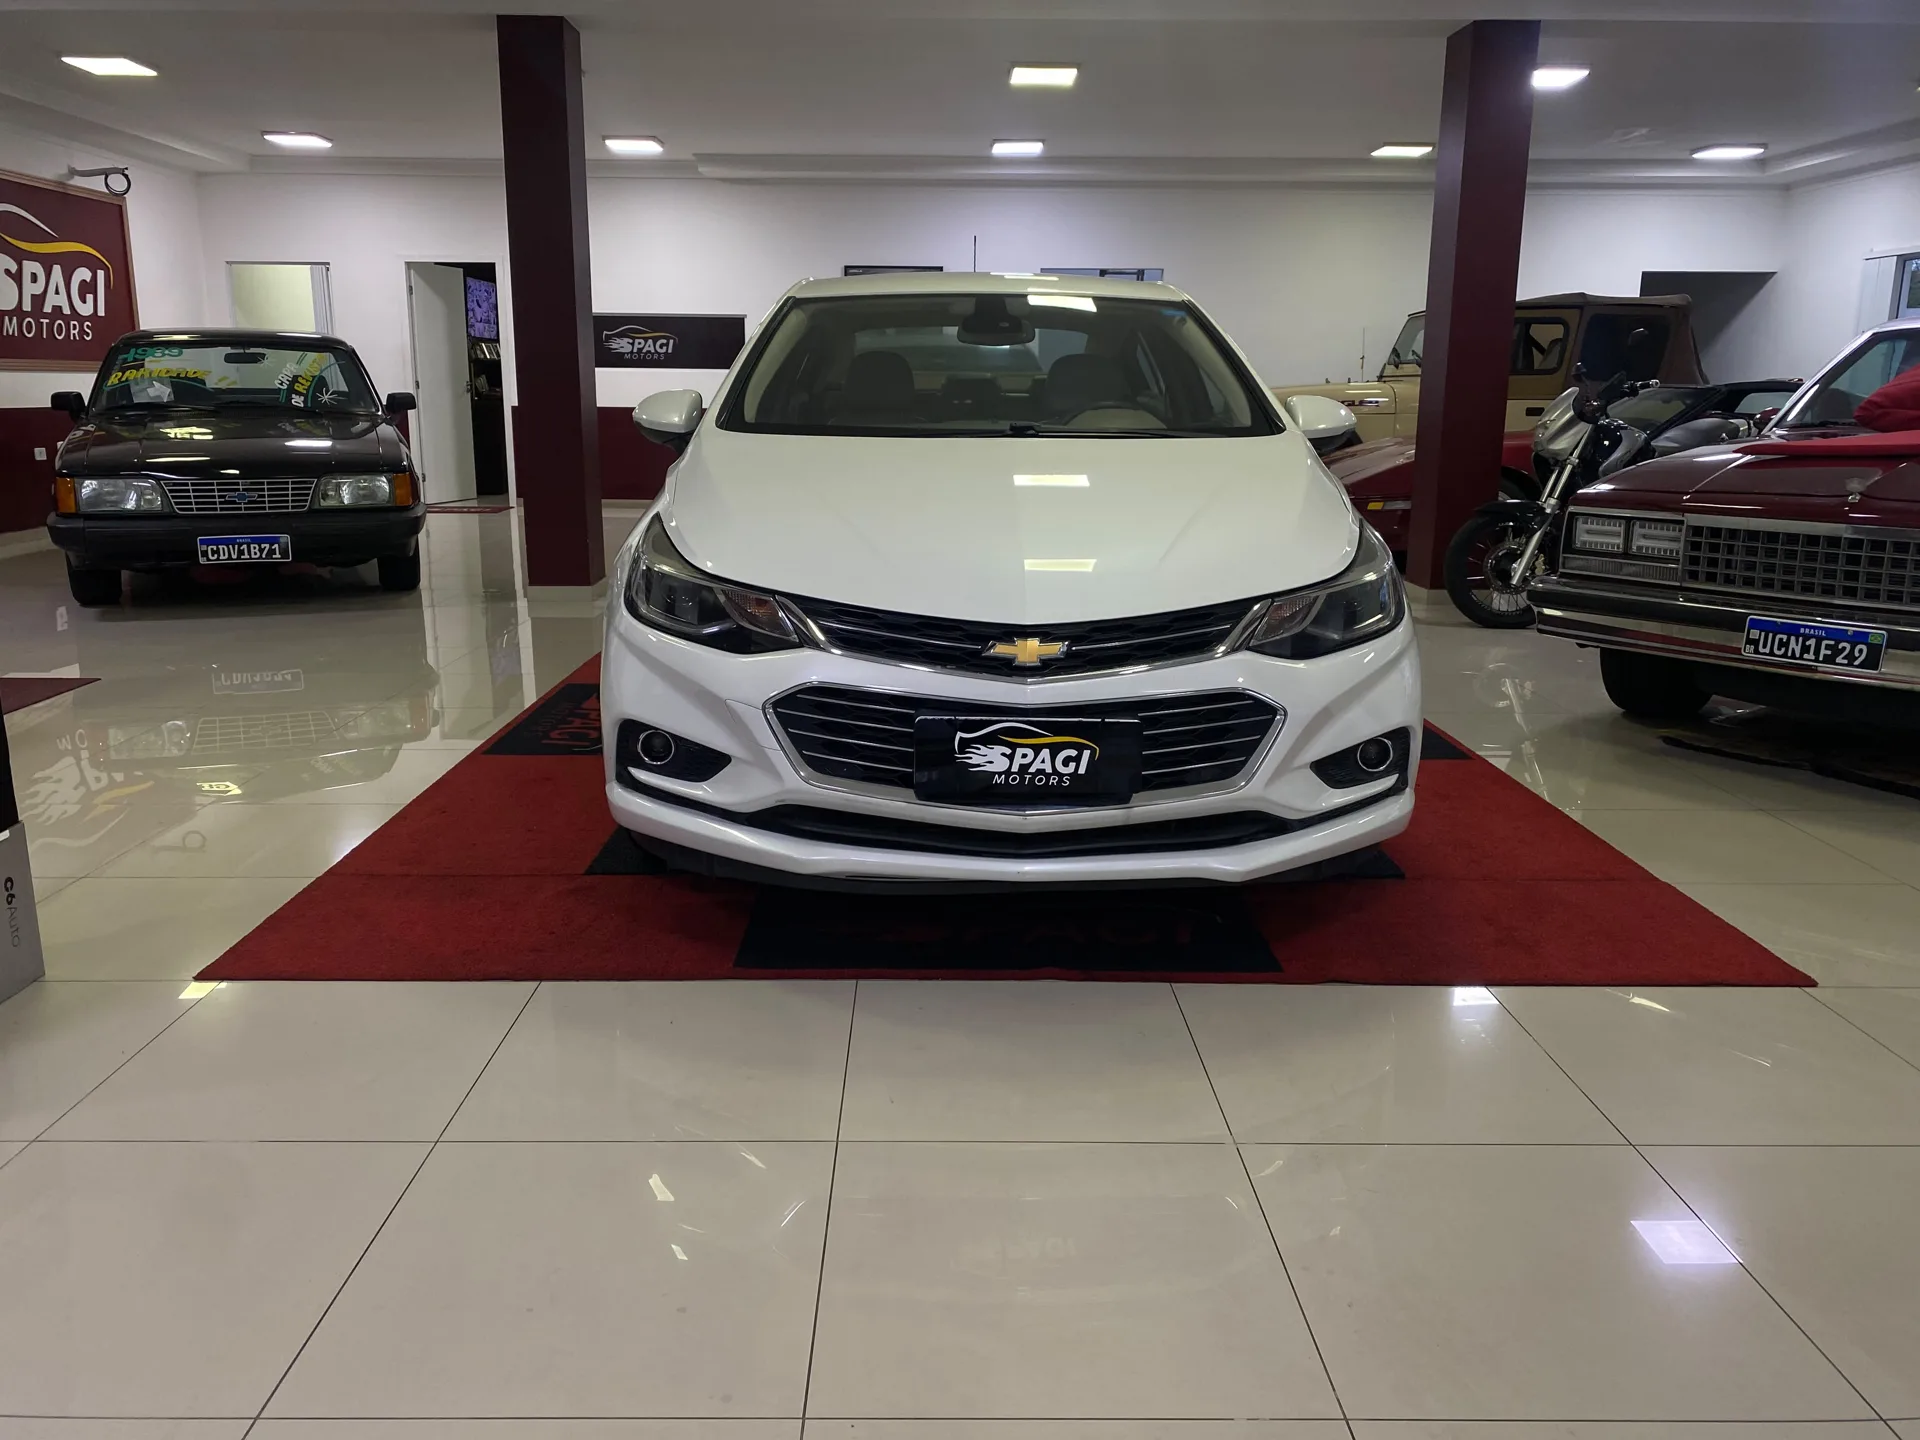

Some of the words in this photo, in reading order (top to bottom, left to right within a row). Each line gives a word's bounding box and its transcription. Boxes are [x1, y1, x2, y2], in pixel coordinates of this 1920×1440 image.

[0, 253, 105, 316] SPAGI
[2, 315, 93, 340] MOTORS
[119, 346, 183, 361] 1989
[604, 337, 674, 353] SPAGI
[207, 543, 282, 560] CDV1B71
[1799, 627, 1827, 637] BRASIL
[1745, 644, 1754, 654] BR
[1758, 631, 1867, 666] UCN1F29
[955, 745, 1091, 774] SPAGI
[992, 773, 1070, 786] MOTORS
